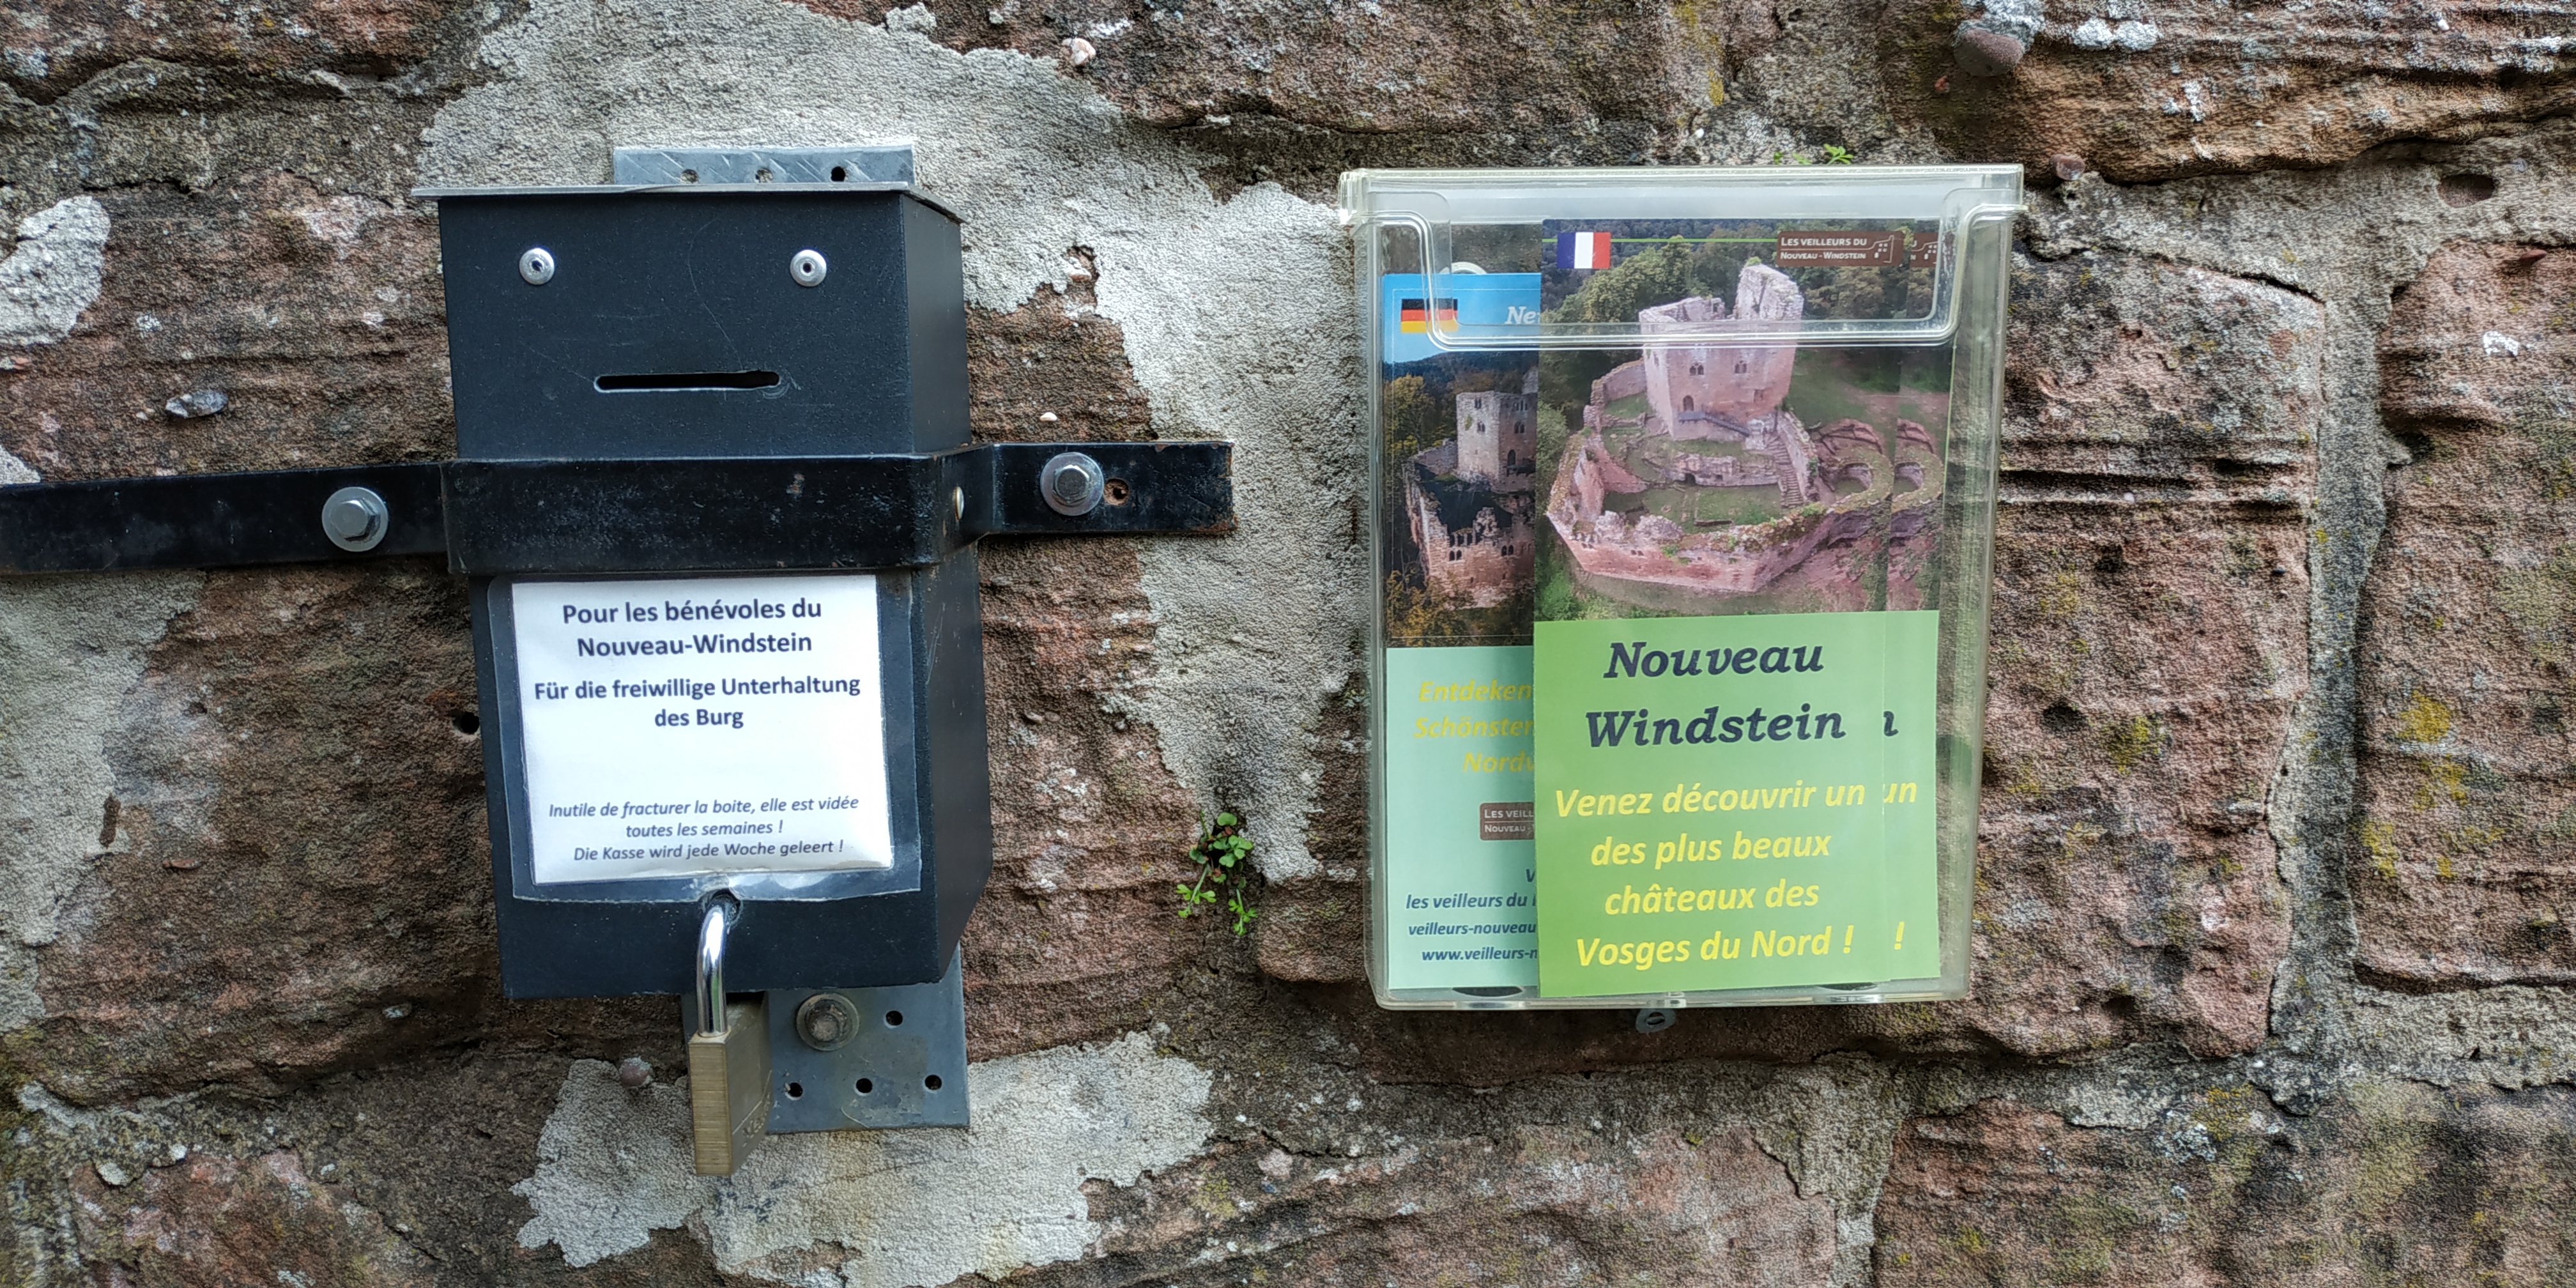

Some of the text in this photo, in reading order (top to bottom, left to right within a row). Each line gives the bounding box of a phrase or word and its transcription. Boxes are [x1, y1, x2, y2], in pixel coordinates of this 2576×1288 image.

[1781, 237, 1798, 246] LES
[1800, 238, 1851, 246] VEILLEURS
[563, 597, 822, 624] Pour les bénévoles du
[577, 632, 812, 657] Nouveau-Windstein
[1602, 641, 1824, 678] Nouveau
[535, 675, 861, 700] Für die freiwillige Unterhaltung
[1418, 678, 1531, 701] Entdeken
[654, 709, 744, 729] des Burg
[1584, 703, 1846, 748] Windstein
[549, 795, 859, 819] Inutile de fracturer la boite, elle est vidée
[1556, 779, 1865, 817] Venez découvrir un
[1484, 809, 1504, 818] LES
[625, 819, 783, 838] toutes les semaines !
[574, 839, 844, 861] Die Kasse wird jede Woche geleert !
[1590, 830, 1831, 870] des plus beaux
[1406, 894, 1429, 910] les
[1433, 893, 1503, 909] veilleurs
[1506, 892, 1528, 907] du
[1605, 878, 1819, 915] châteaux des
[1577, 924, 1854, 970] Vosges du Nord !
